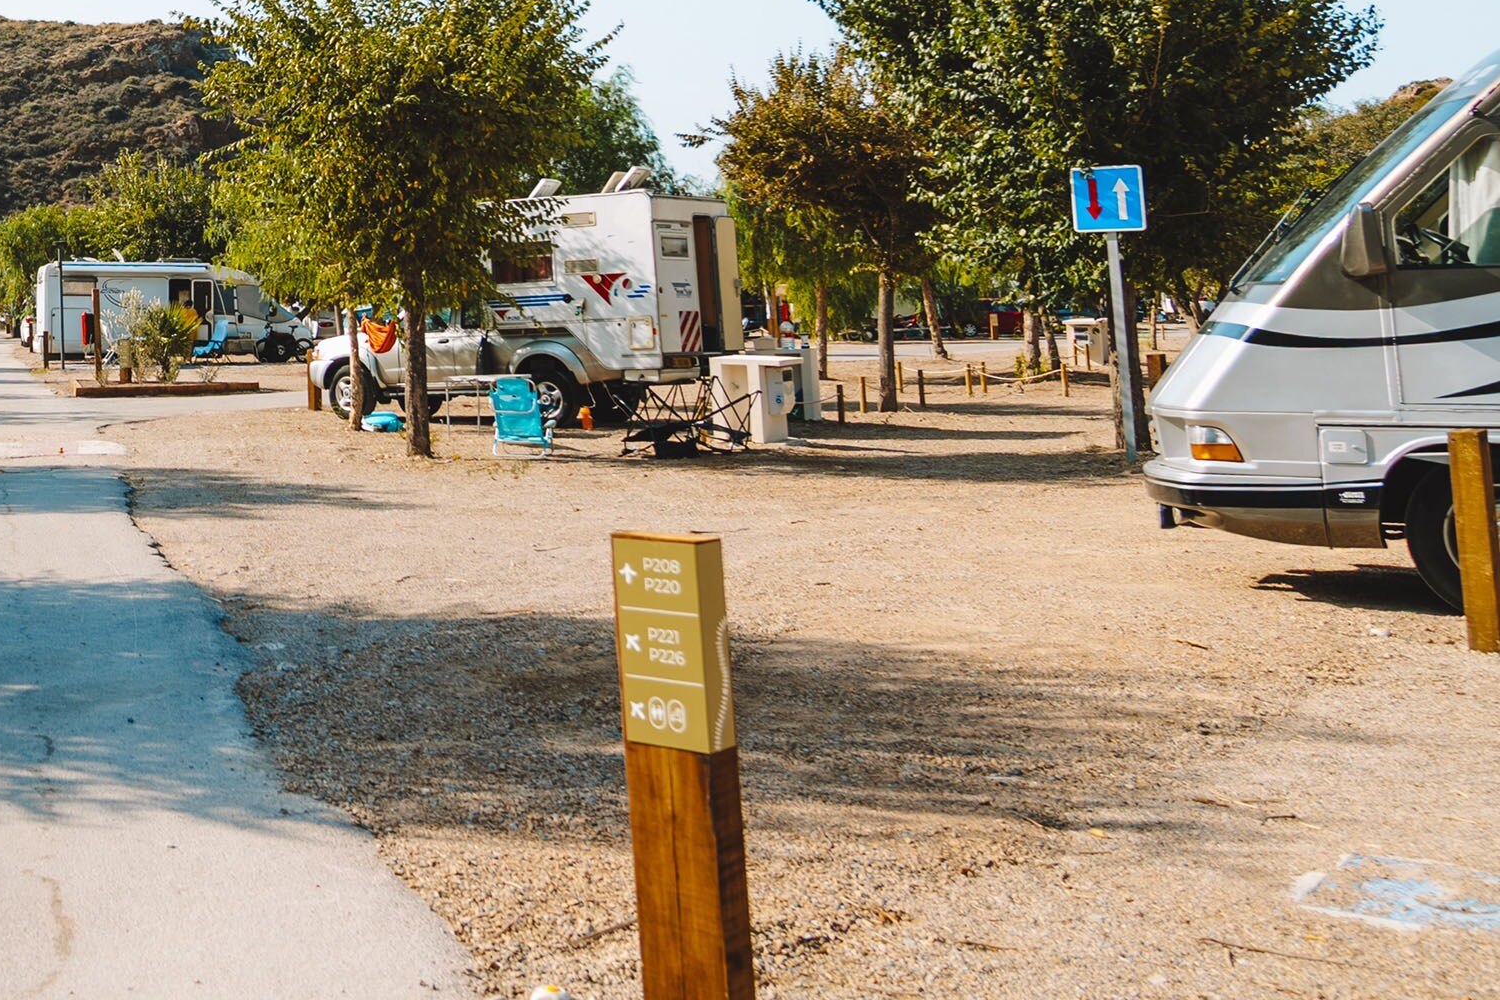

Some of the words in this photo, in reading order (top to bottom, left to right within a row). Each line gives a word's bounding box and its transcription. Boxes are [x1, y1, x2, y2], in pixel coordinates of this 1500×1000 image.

[642, 557, 681, 575] P208
[644, 578, 681, 595] P220
[648, 627, 680, 645] P221
[649, 648, 686, 666] P226
